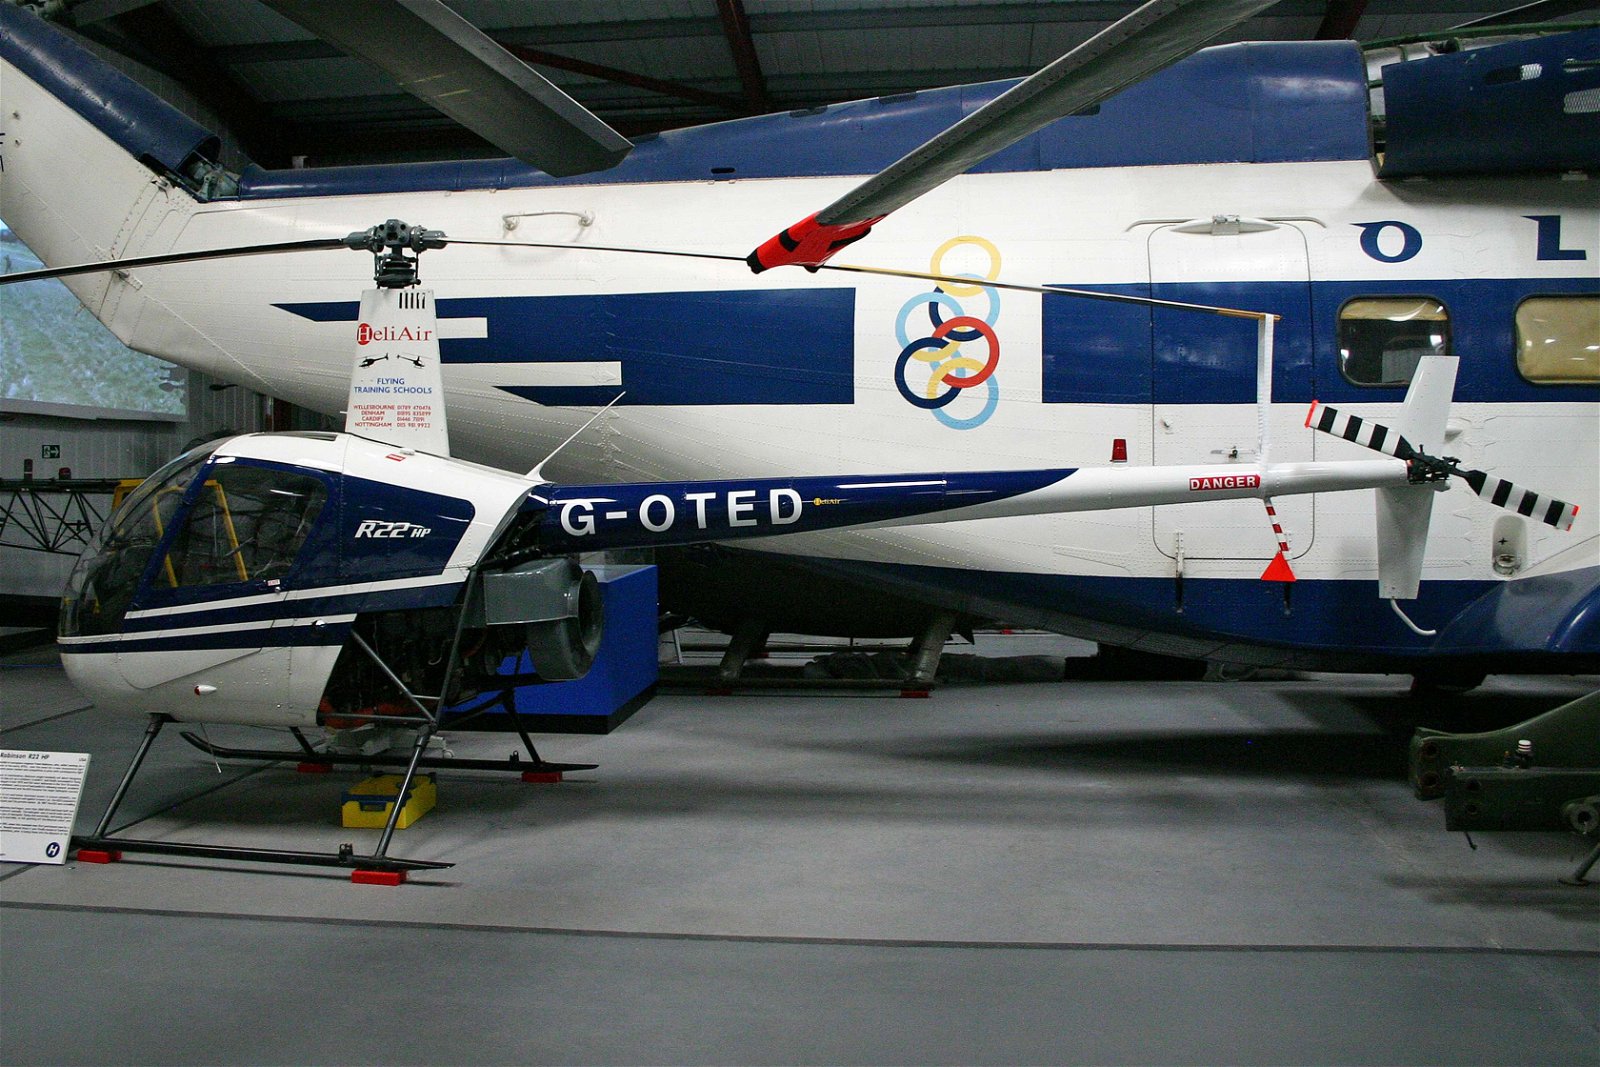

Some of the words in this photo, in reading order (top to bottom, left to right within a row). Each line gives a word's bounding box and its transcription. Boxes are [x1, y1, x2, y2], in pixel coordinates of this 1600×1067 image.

[357, 323, 432, 345] HeliAir
[377, 377, 405, 385] FLYING
[354, 386, 391, 394] TRAINING
[393, 386, 432, 394] SCHOOLS
[1190, 476, 1256, 490] DANGER
[560, 488, 803, 537] G-OTED
[355, 520, 411, 538] R22
[410, 528, 431, 538] HP
